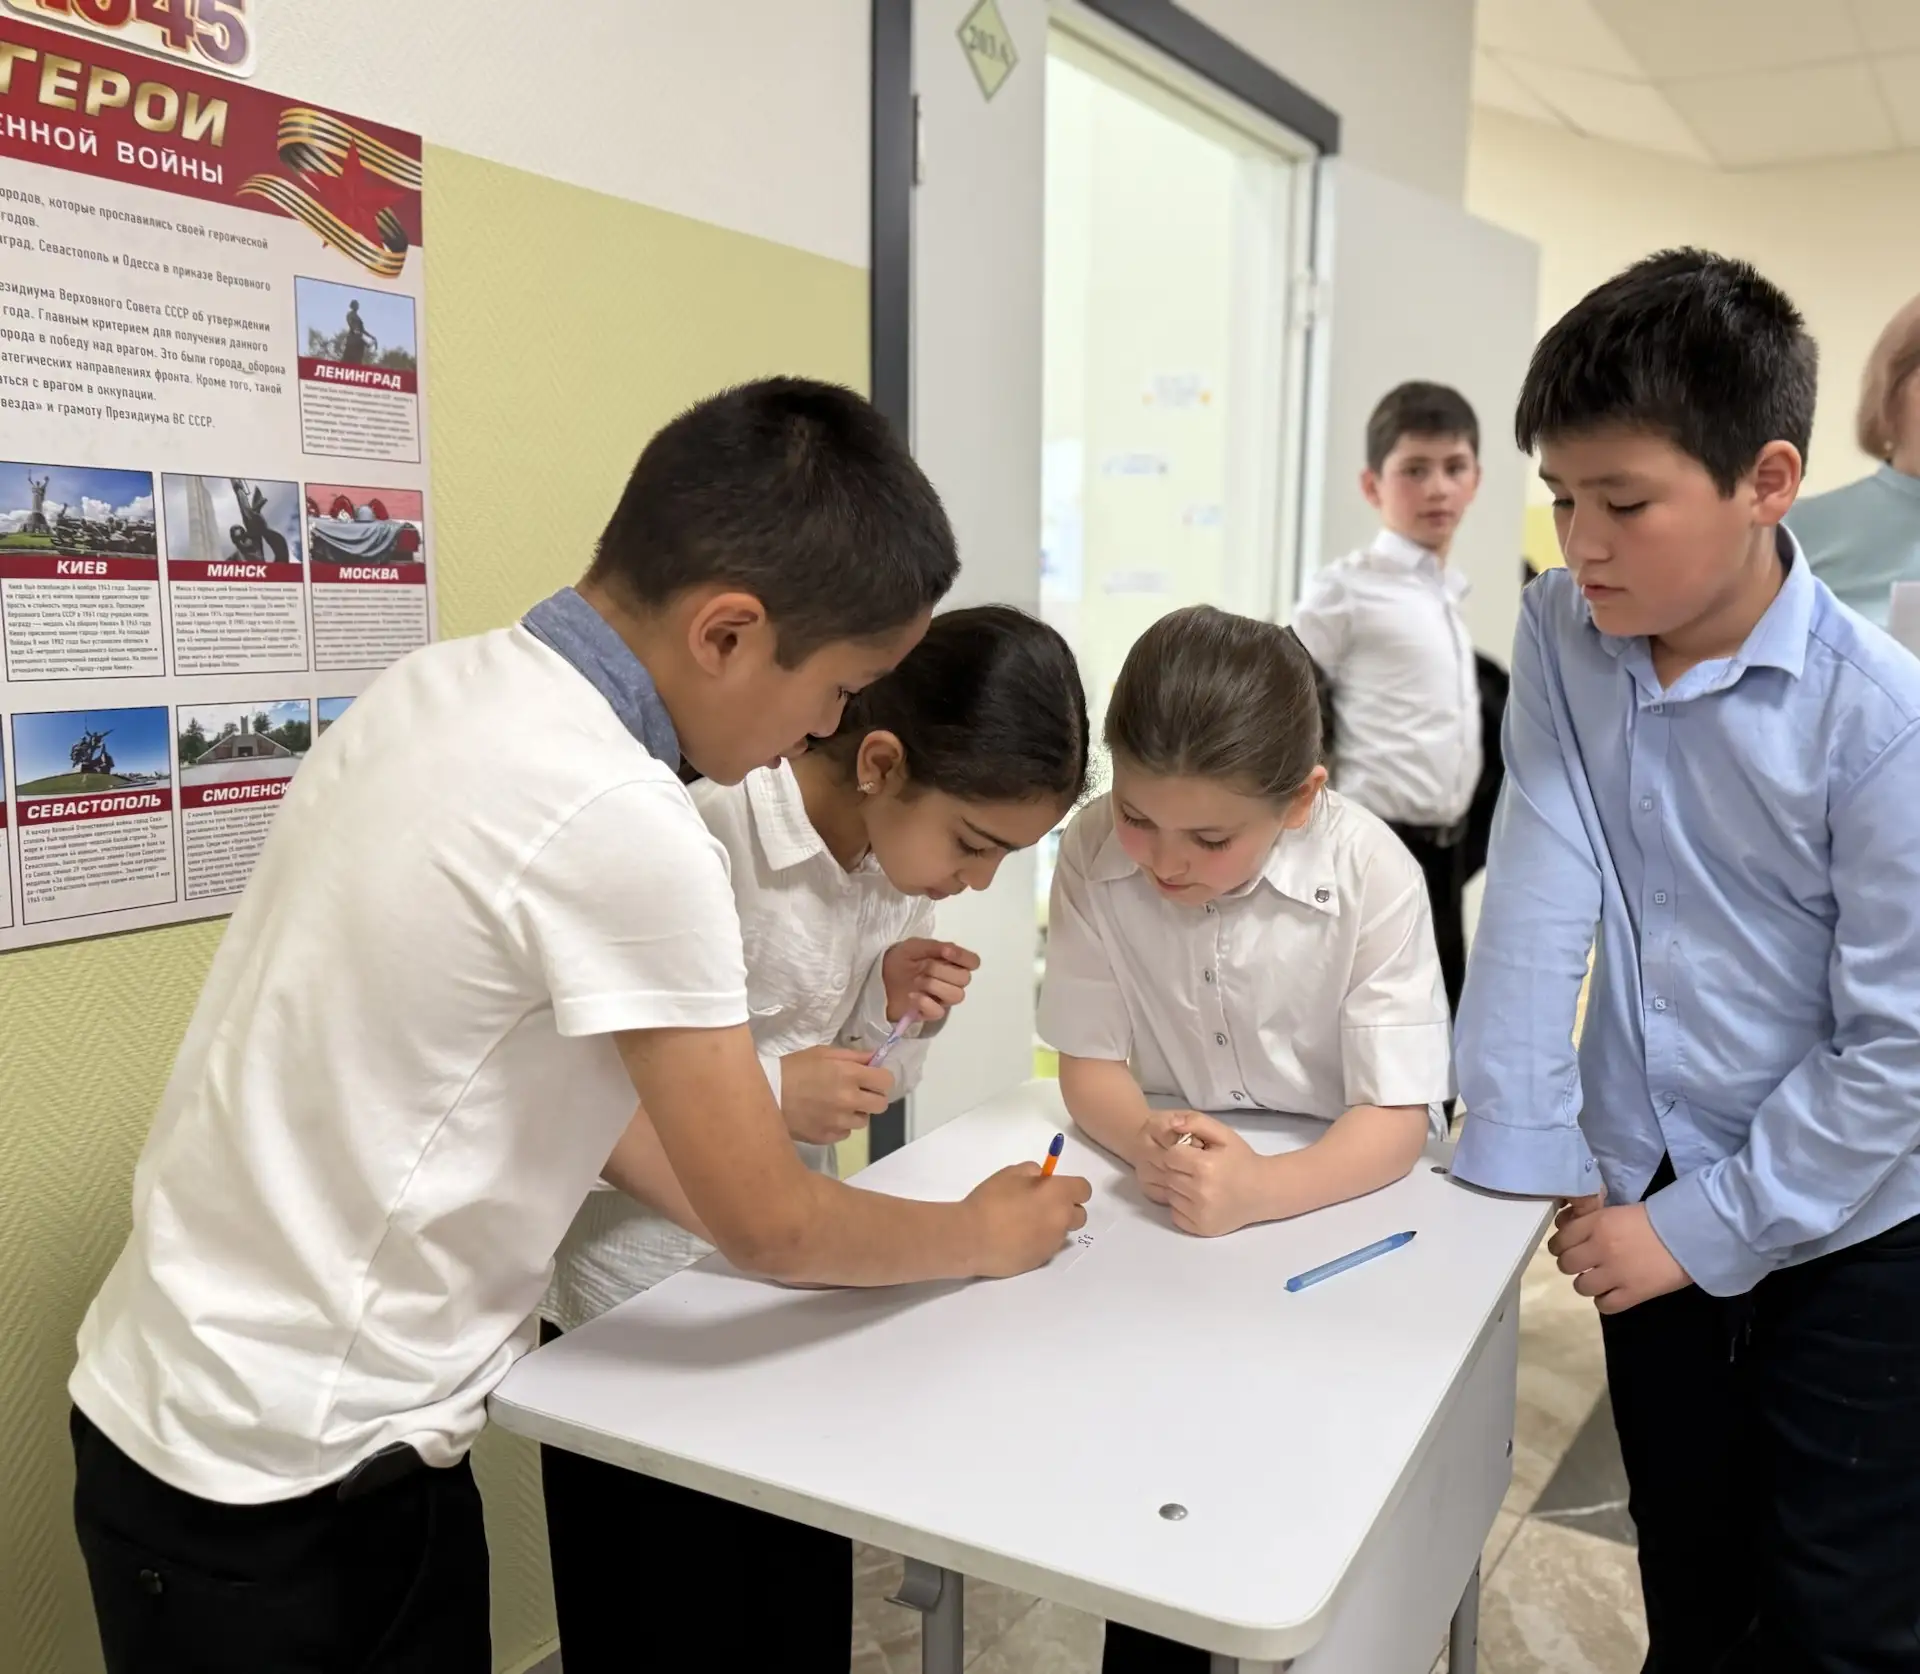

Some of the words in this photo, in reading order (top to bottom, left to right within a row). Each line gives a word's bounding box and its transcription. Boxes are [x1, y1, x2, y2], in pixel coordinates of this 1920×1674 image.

[0, 113, 98, 157] ННОЙ
[116, 140, 224, 186] ВОЙНЫ
[0, 211, 39, 227] годов.
[49, 198, 96, 215] которые
[99, 208, 172, 230] прославились
[176, 223, 205, 236] своей
[208, 230, 268, 249] героической
[39, 239, 109, 262] Севастополь
[112, 255, 119, 265] и
[122, 254, 160, 272] Одесса
[163, 264, 169, 273] в
[172, 266, 213, 281] приказе
[216, 271, 271, 291] Верховного
[59, 288, 123, 309] Верховного
[126, 299, 161, 315] Совета
[164, 305, 189, 319] СССР
[192, 310, 204, 322] об
[207, 315, 270, 332] утверждении
[3, 306, 34, 319] года.
[38, 308, 89, 327] Главным
[92, 319, 149, 335] критерием
[153, 328, 172, 338] для
[175, 331, 226, 346] получения
[229, 339, 268, 352] данного
[0, 328, 35, 343] орода
[39, 333, 46, 343] в
[49, 334, 89, 351] победу
[93, 341, 113, 353] над
[116, 344, 158, 358] врагом.
[160, 347, 178, 360] Это
[181, 350, 206, 364] были
[209, 357, 245, 374] города,
[247, 360, 286, 375] оборона
[1, 352, 72, 369] атегических
[76, 361, 151, 378] направлениях
[154, 369, 192, 383] фронта.
[196, 373, 226, 388] Кроме
[229, 375, 252, 392] того,
[255, 383, 282, 394] такой
[313, 364, 402, 390] ЛЕНИНГРАД
[32, 378, 39, 388] с
[43, 380, 83, 392] врагом
[87, 384, 94, 394] в
[97, 386, 156, 400] оккупации.
[0, 398, 42, 411] везда»
[46, 403, 54, 412] и
[58, 404, 102, 419] грамоту
[106, 406, 170, 424] Президиума
[172, 412, 185, 425] ВС
[188, 414, 215, 428] СССР.
[56, 560, 108, 575] КИЕВ
[207, 563, 268, 578] МИНСК
[339, 567, 399, 580] МОСКВА
[27, 795, 162, 818] СЕВАСТОПОЛЬ
